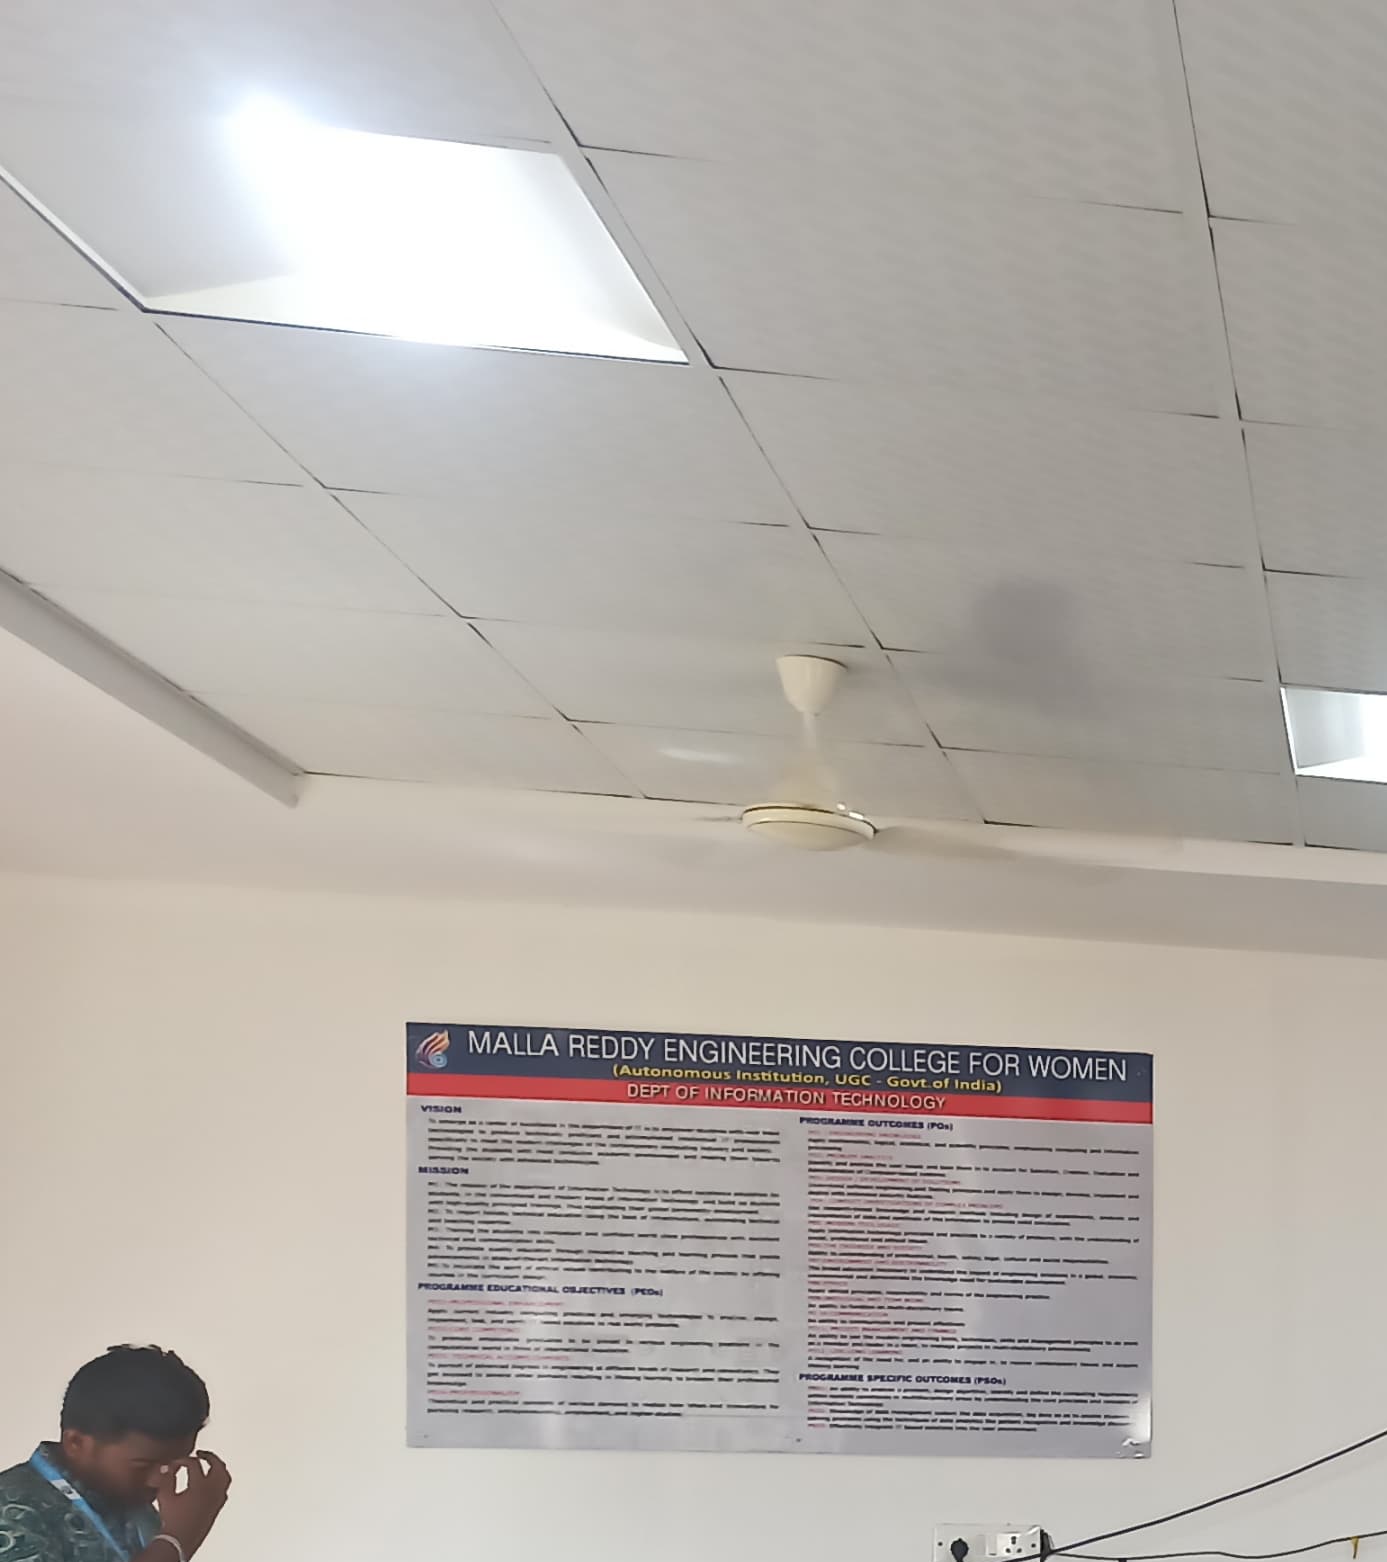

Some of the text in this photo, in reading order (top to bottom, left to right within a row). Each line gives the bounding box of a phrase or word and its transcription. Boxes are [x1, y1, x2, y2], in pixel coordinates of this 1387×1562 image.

[468, 1030, 1127, 1082] MALLA REDDY ENGINEERING COLLEGE FOR WOMEN
[612, 1064, 731, 1081] (Autonomous
[737, 1069, 830, 1087] Institution,
[835, 1074, 872, 1087] UGC
[955, 1079, 1003, 1094] India)
[420, 1104, 462, 1114] VISION
[627, 1084, 946, 1110] DEPT OF INFORMATION TECHNOLOGY
